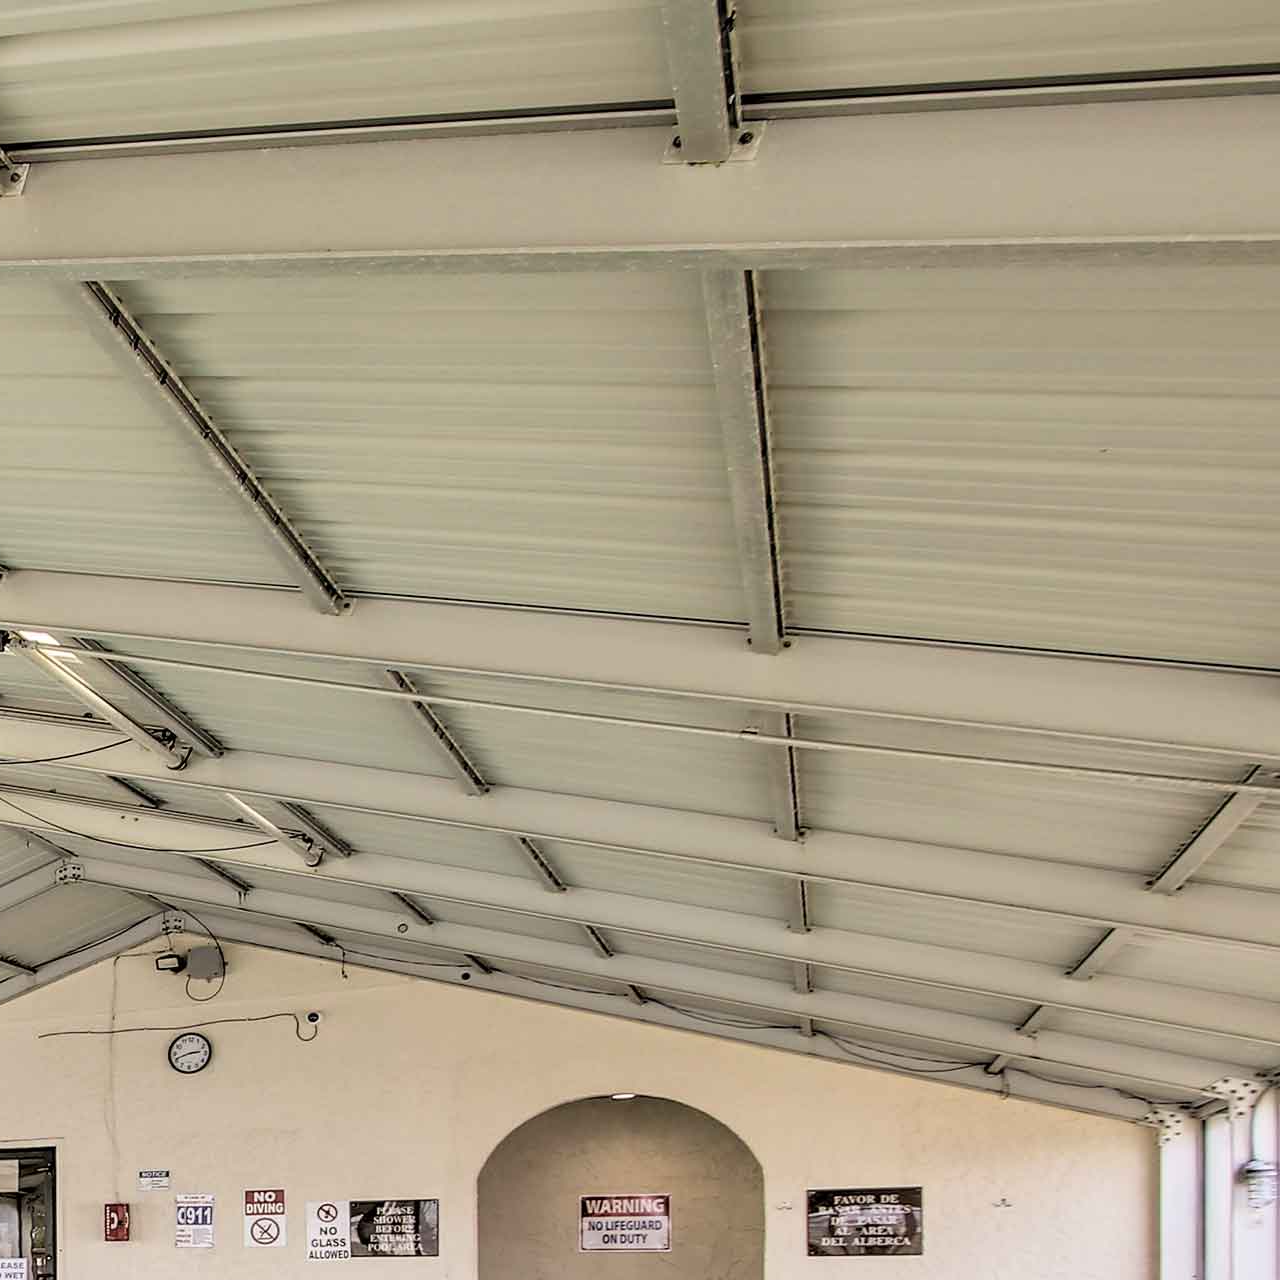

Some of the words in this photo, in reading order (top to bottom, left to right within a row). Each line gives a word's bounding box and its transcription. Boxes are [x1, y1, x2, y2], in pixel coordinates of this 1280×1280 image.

[254, 1192, 275, 1202] NO
[833, 1195, 876, 1204] FAVOR
[880, 1194, 900, 1203] DE
[246, 1203, 284, 1214] DIVING
[586, 1198, 665, 1214] WARNING
[376, 1207, 414, 1215] PLEASE
[373, 1216, 416, 1224] SHOWER
[831, 1216, 848, 1225] DE
[375, 1225, 415, 1233] BEFORE
[588, 1221, 603, 1231] NO
[606, 1220, 662, 1231] LIFEGUARD
[320, 1226, 338, 1235] NO
[834, 1227, 851, 1235] AL
[860, 1226, 894, 1235] AREA
[370, 1234, 421, 1242] ENTERING
[602, 1234, 617, 1244] ON
[620, 1234, 648, 1244] DUTY
[852, 1237, 911, 1245] ALBERCA
[311, 1238, 346, 1248] GLASS
[397, 1242, 423, 1251] AREA
[309, 1250, 349, 1259] ALLOWED
